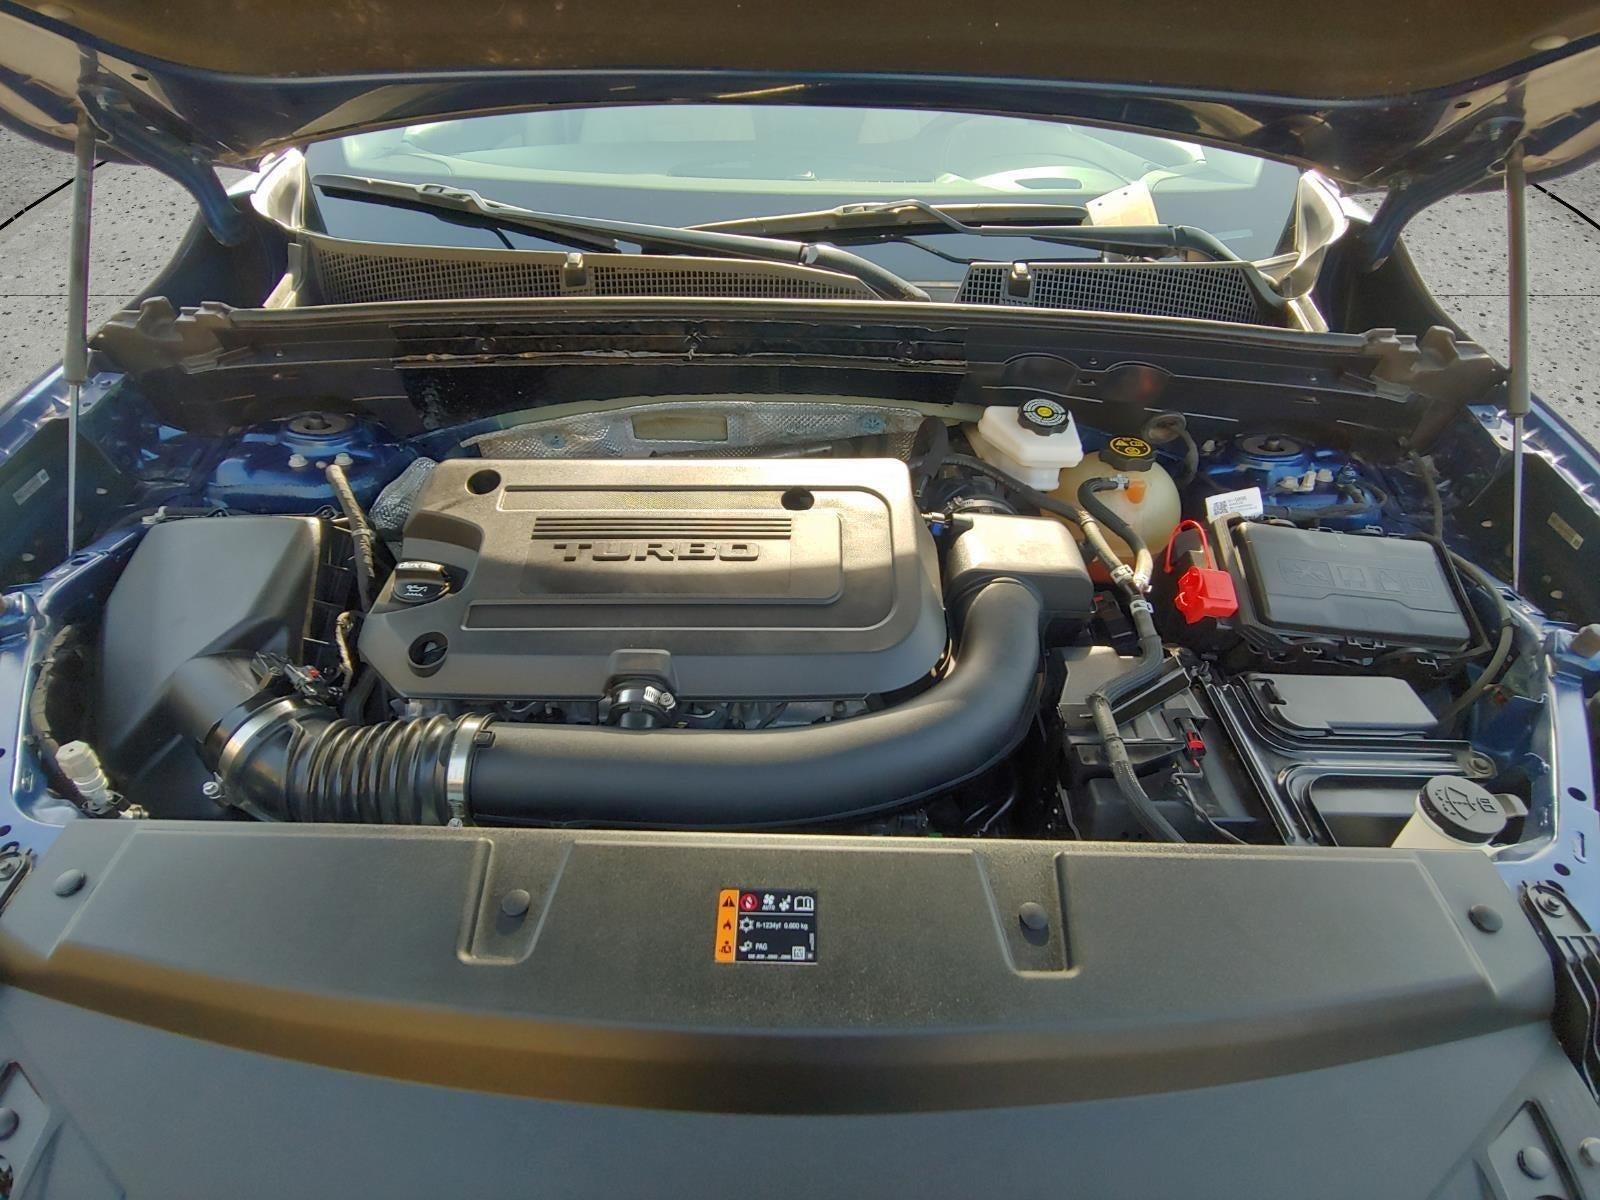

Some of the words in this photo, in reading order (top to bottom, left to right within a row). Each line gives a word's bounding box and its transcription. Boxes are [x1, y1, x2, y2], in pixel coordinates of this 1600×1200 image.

[552, 542, 760, 562] TURBO
[755, 921, 781, 930] R-1234yf
[801, 922, 808, 931] kg
[755, 943, 768, 951] PAG
